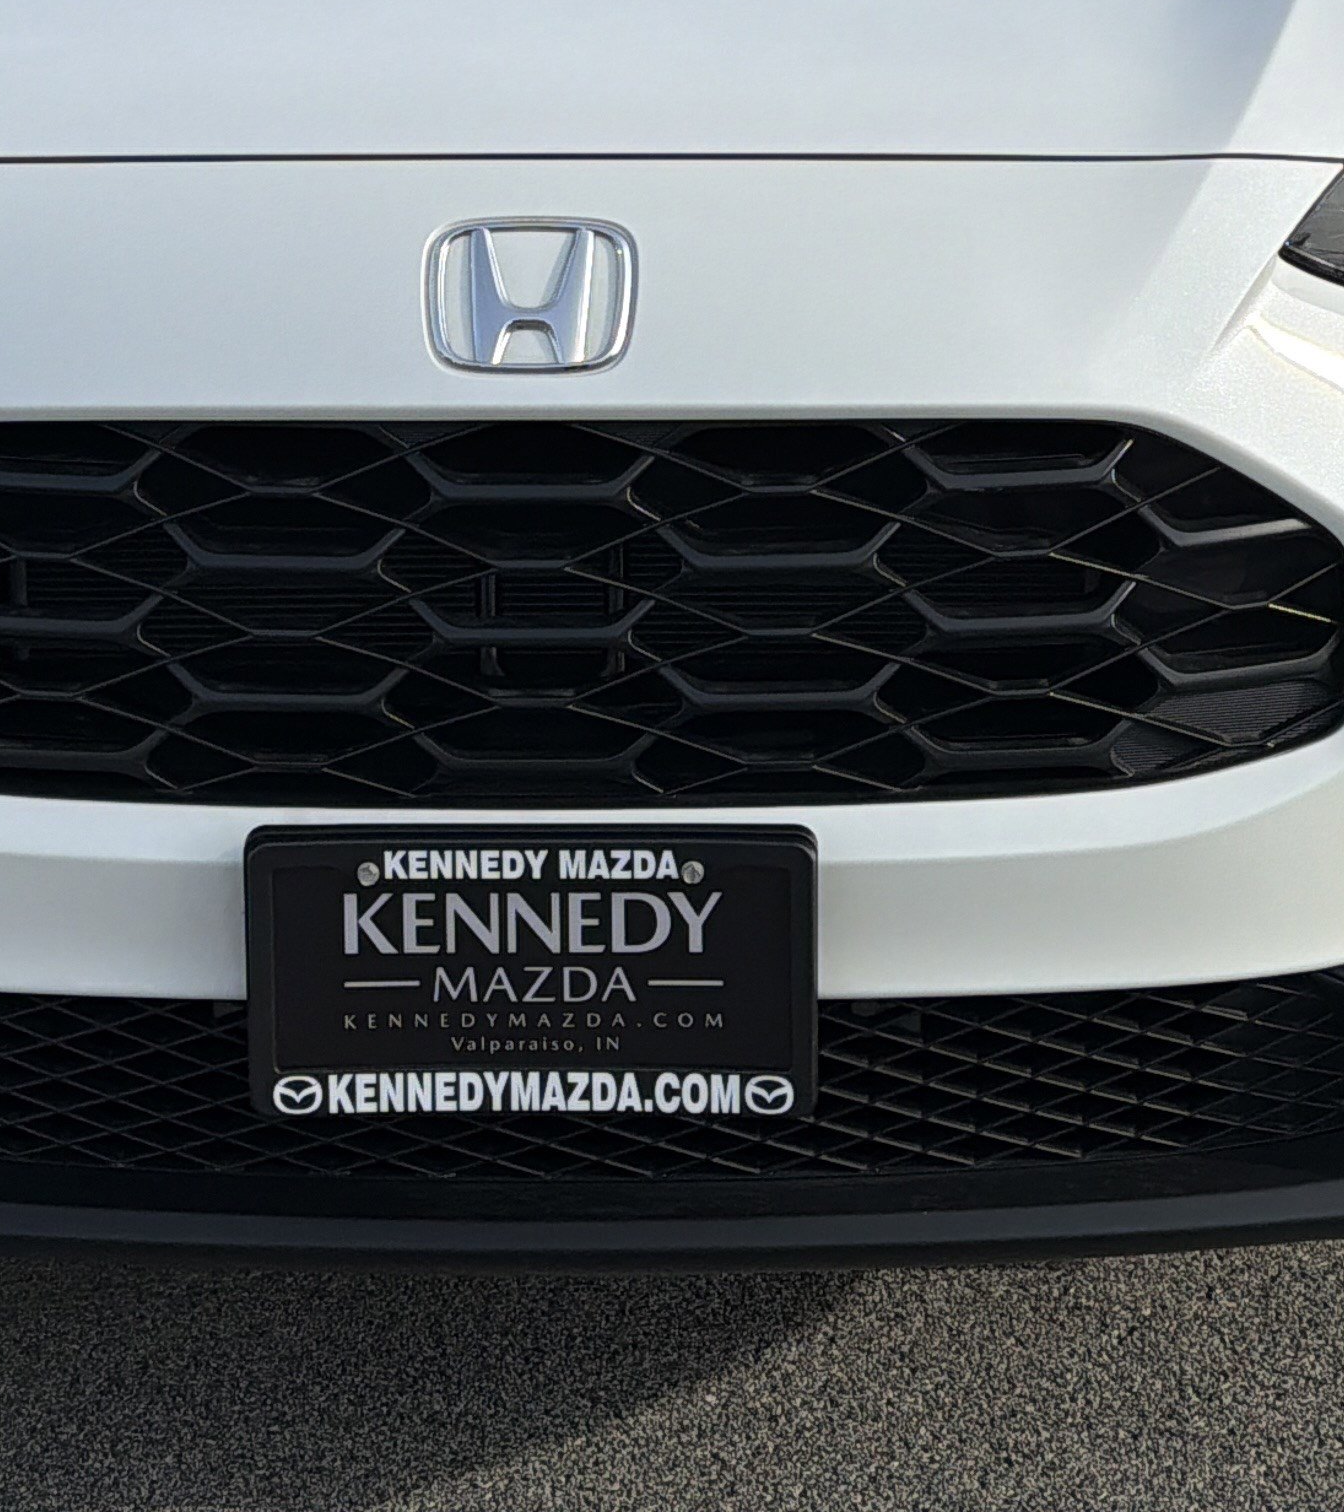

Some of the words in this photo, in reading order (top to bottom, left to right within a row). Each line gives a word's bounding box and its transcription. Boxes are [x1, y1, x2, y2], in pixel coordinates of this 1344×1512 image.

[383, 850, 549, 879] KENNEDY
[559, 850, 679, 879] MAZDA
[343, 892, 723, 954] KENNEDY
[433, 966, 637, 1003] MAZDA
[343, 1013, 724, 1029] KENNEDYMAZDA.COM
[451, 1037, 584, 1055] Valparaiso,
[596, 1037, 621, 1051] IN
[328, 1072, 741, 1114] KENNEDYMAZDA.COM
